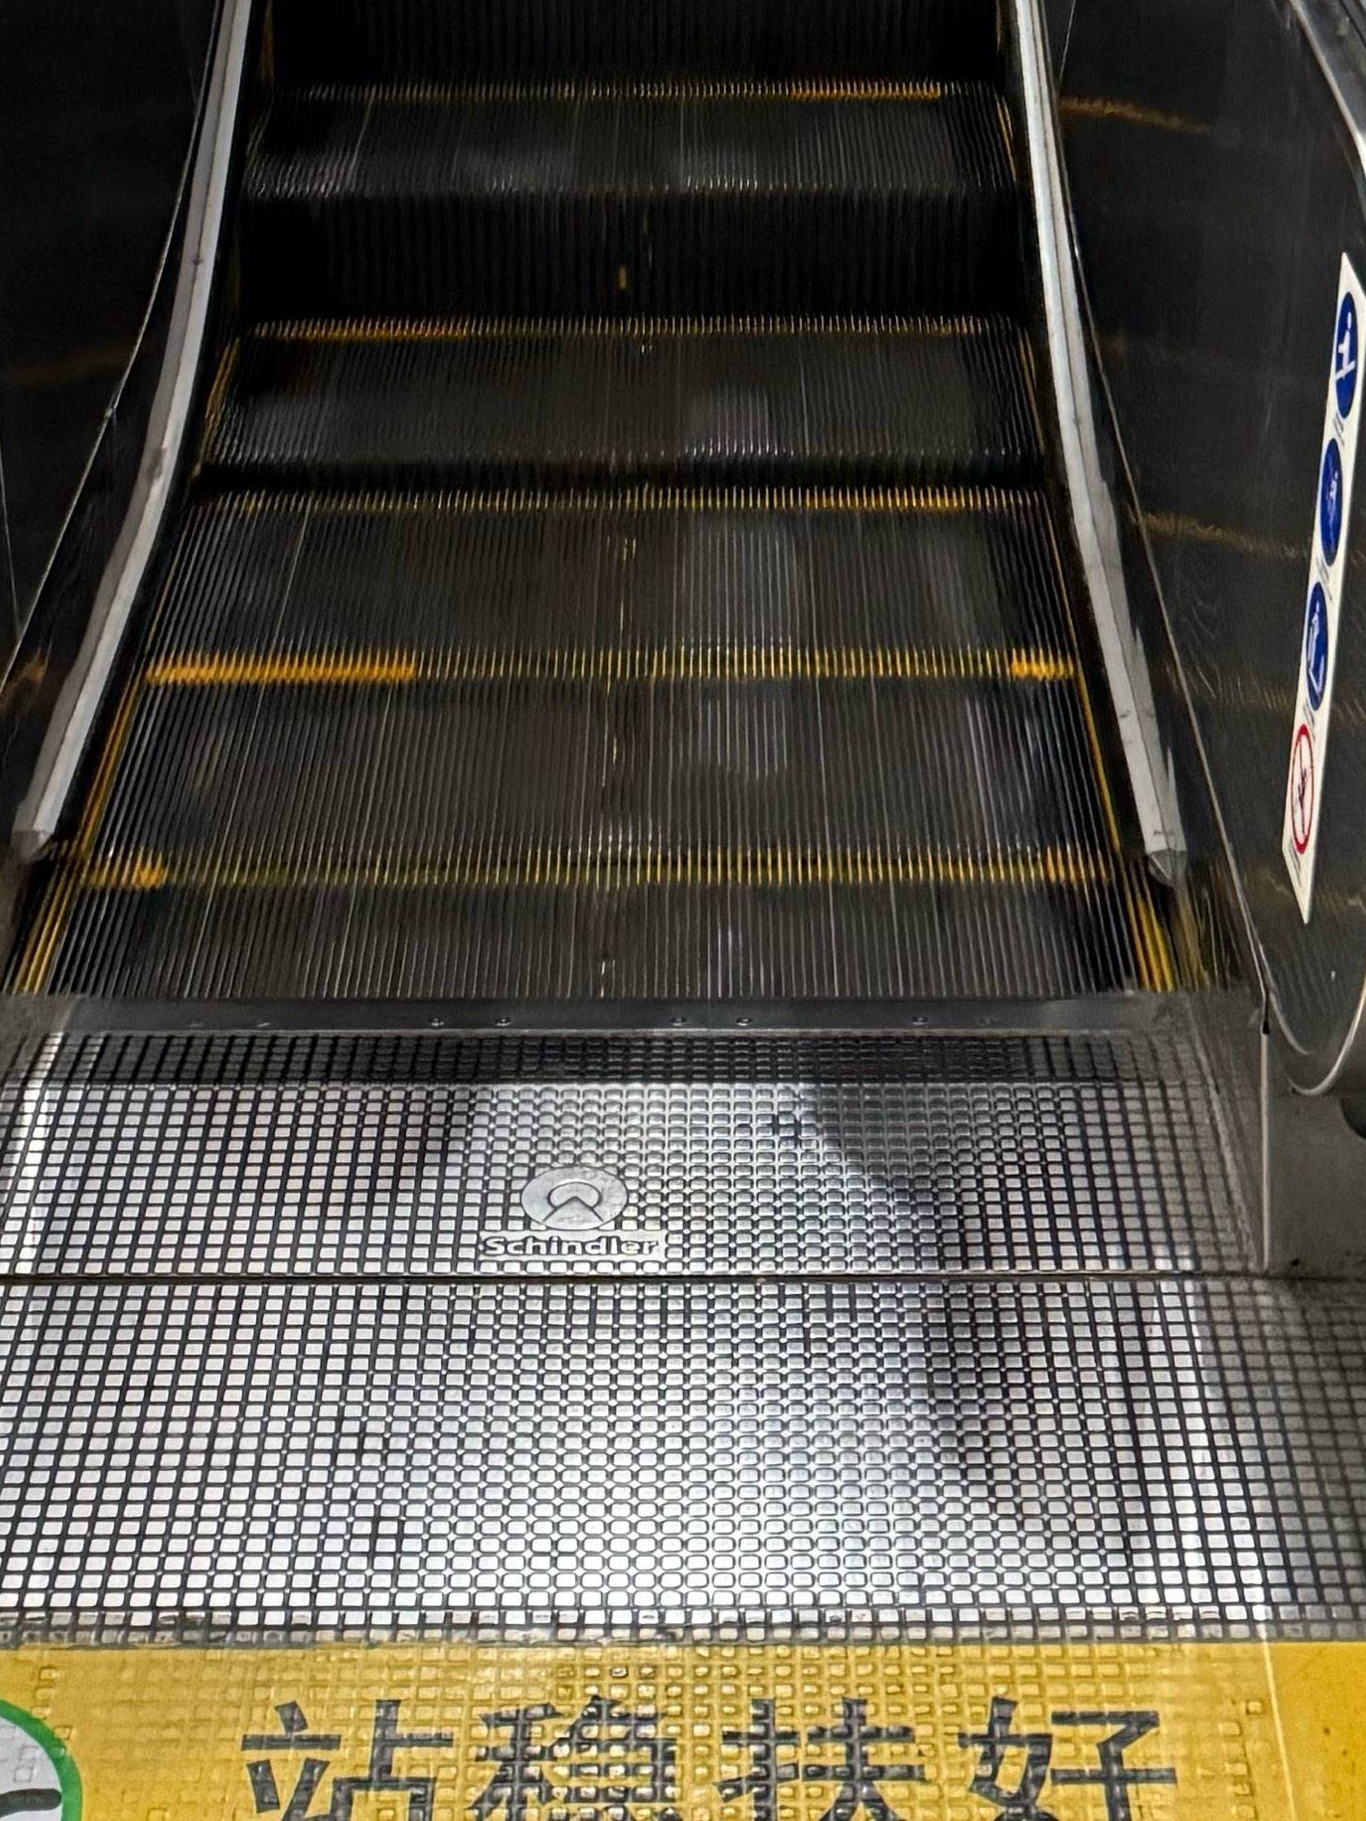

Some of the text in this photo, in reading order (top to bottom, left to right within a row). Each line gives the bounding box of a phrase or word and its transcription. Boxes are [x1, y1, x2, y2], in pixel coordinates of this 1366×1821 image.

[482, 1235, 658, 1257] Schindler
[241, 1695, 1178, 1821] 站稳扶好
